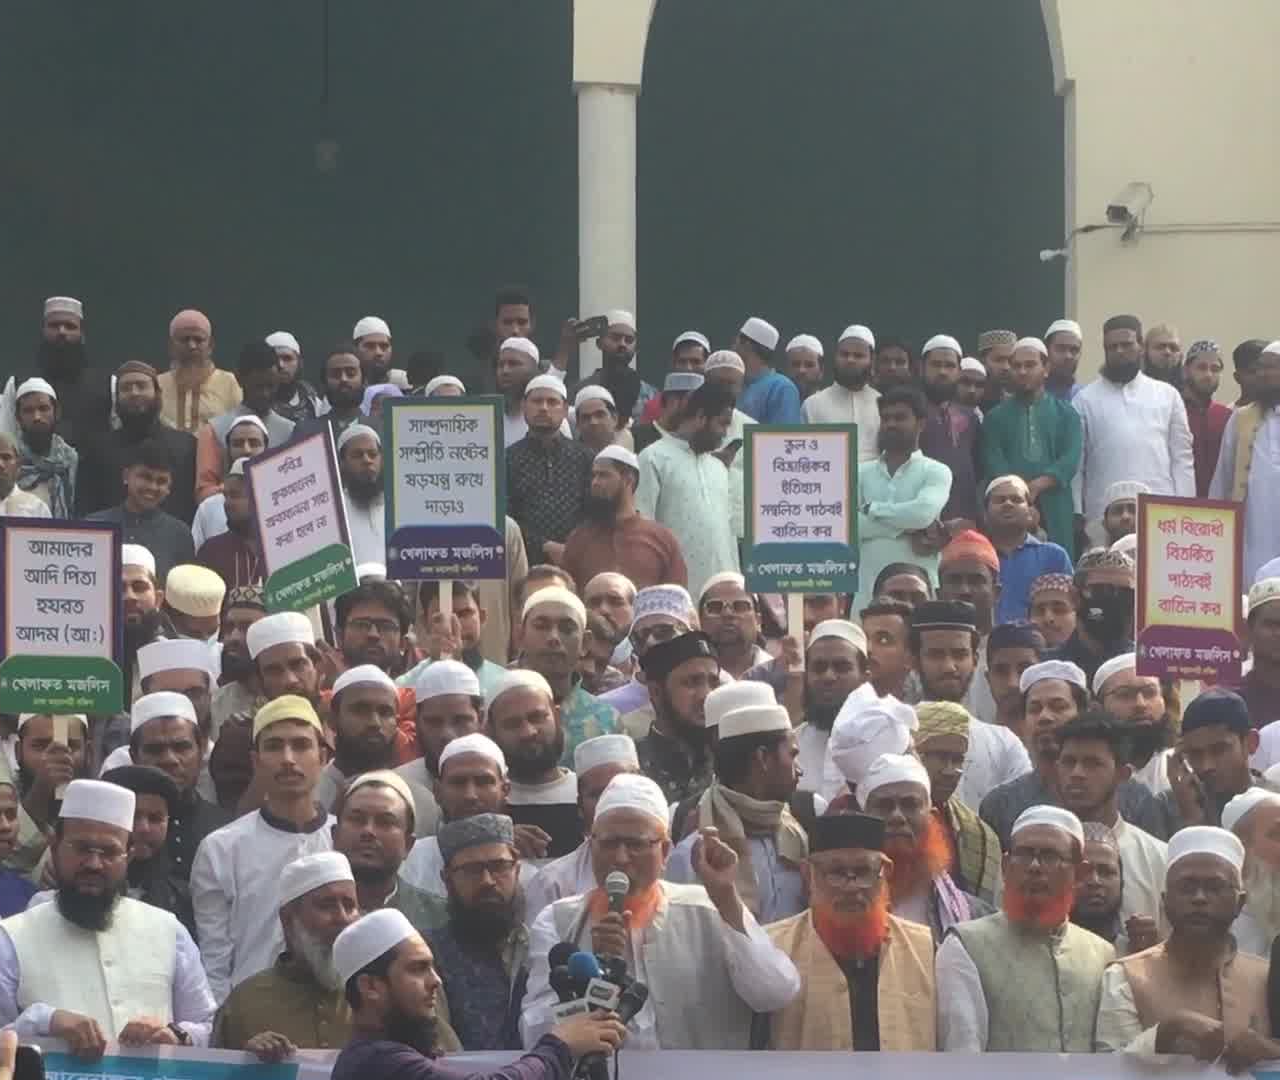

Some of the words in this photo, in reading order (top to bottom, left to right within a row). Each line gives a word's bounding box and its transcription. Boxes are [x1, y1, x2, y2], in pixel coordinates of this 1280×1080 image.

[28, 540, 93, 557] আমাদের
[24, 564, 58, 586] আদি
[62, 564, 96, 586] পিতা
[36, 597, 85, 614] হযরত
[16, 625, 59, 643] আদম
